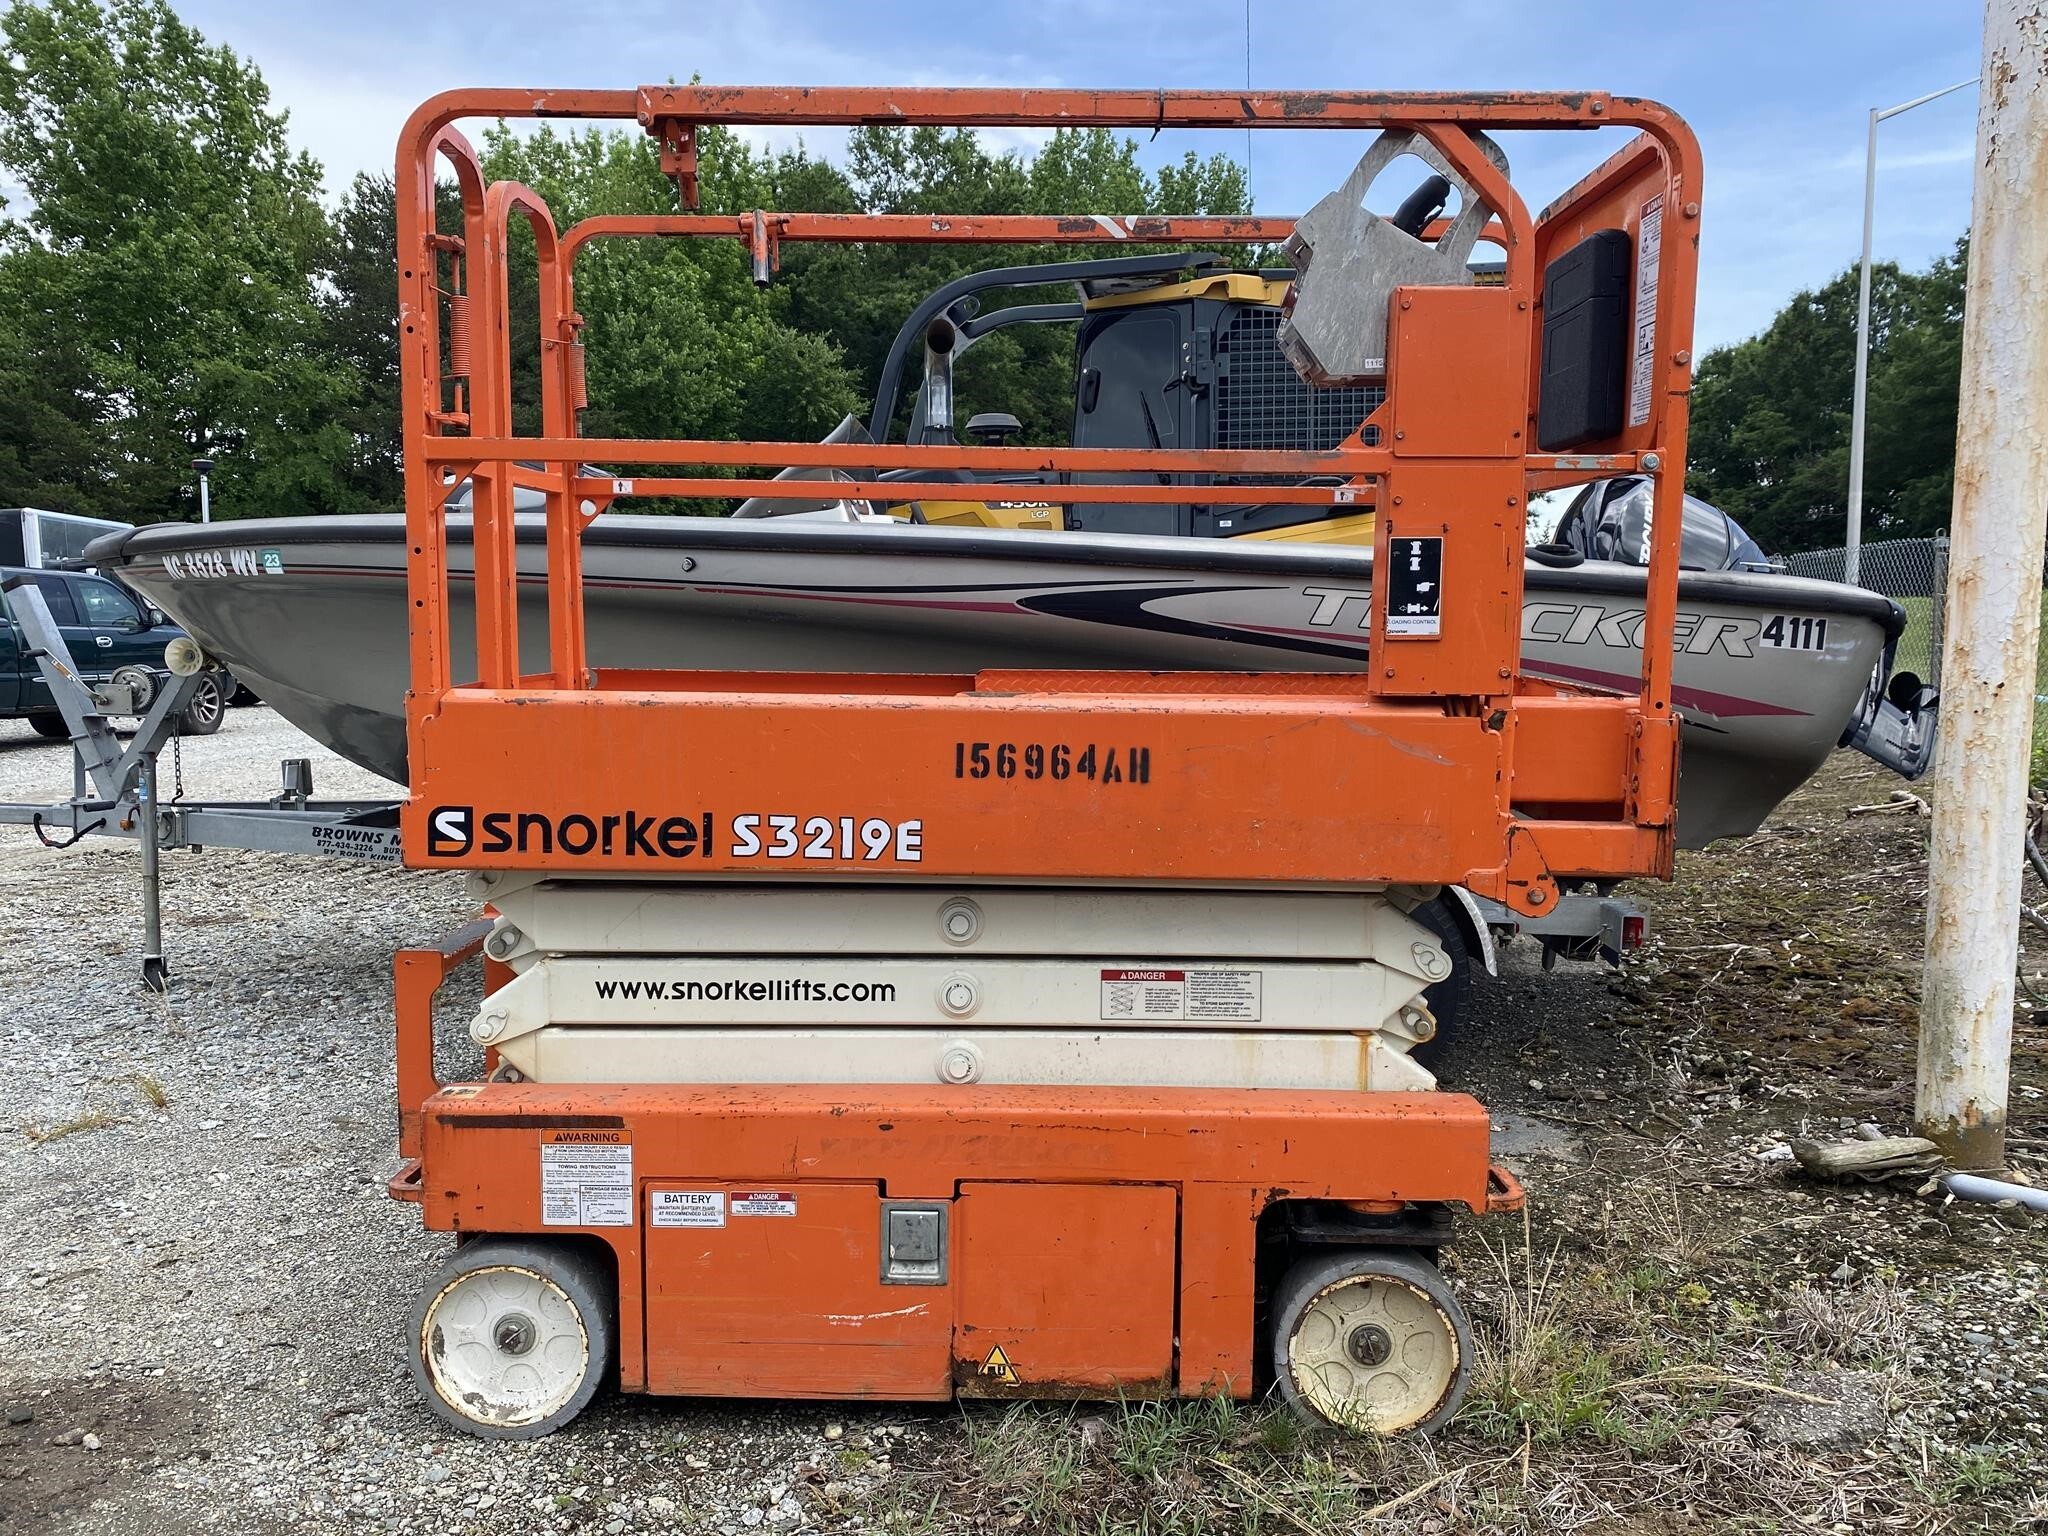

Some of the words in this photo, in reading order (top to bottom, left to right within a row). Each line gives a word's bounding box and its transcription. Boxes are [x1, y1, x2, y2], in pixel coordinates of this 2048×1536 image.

[264, 553, 280, 566] 23
[1302, 586, 1762, 658] TCKER
[1762, 615, 1828, 651] 4111
[312, 826, 384, 844] BROWNS
[482, 810, 713, 859] snorkel
[731, 813, 923, 862] S3219E
[340, 850, 366, 859] ROAD
[370, 853, 395, 861] KING
[1128, 971, 1166, 980] DANGER
[595, 979, 896, 1002] www.snorkellifts.com
[563, 1133, 620, 1142] WARNING
[664, 1194, 712, 1204] BATTERY
